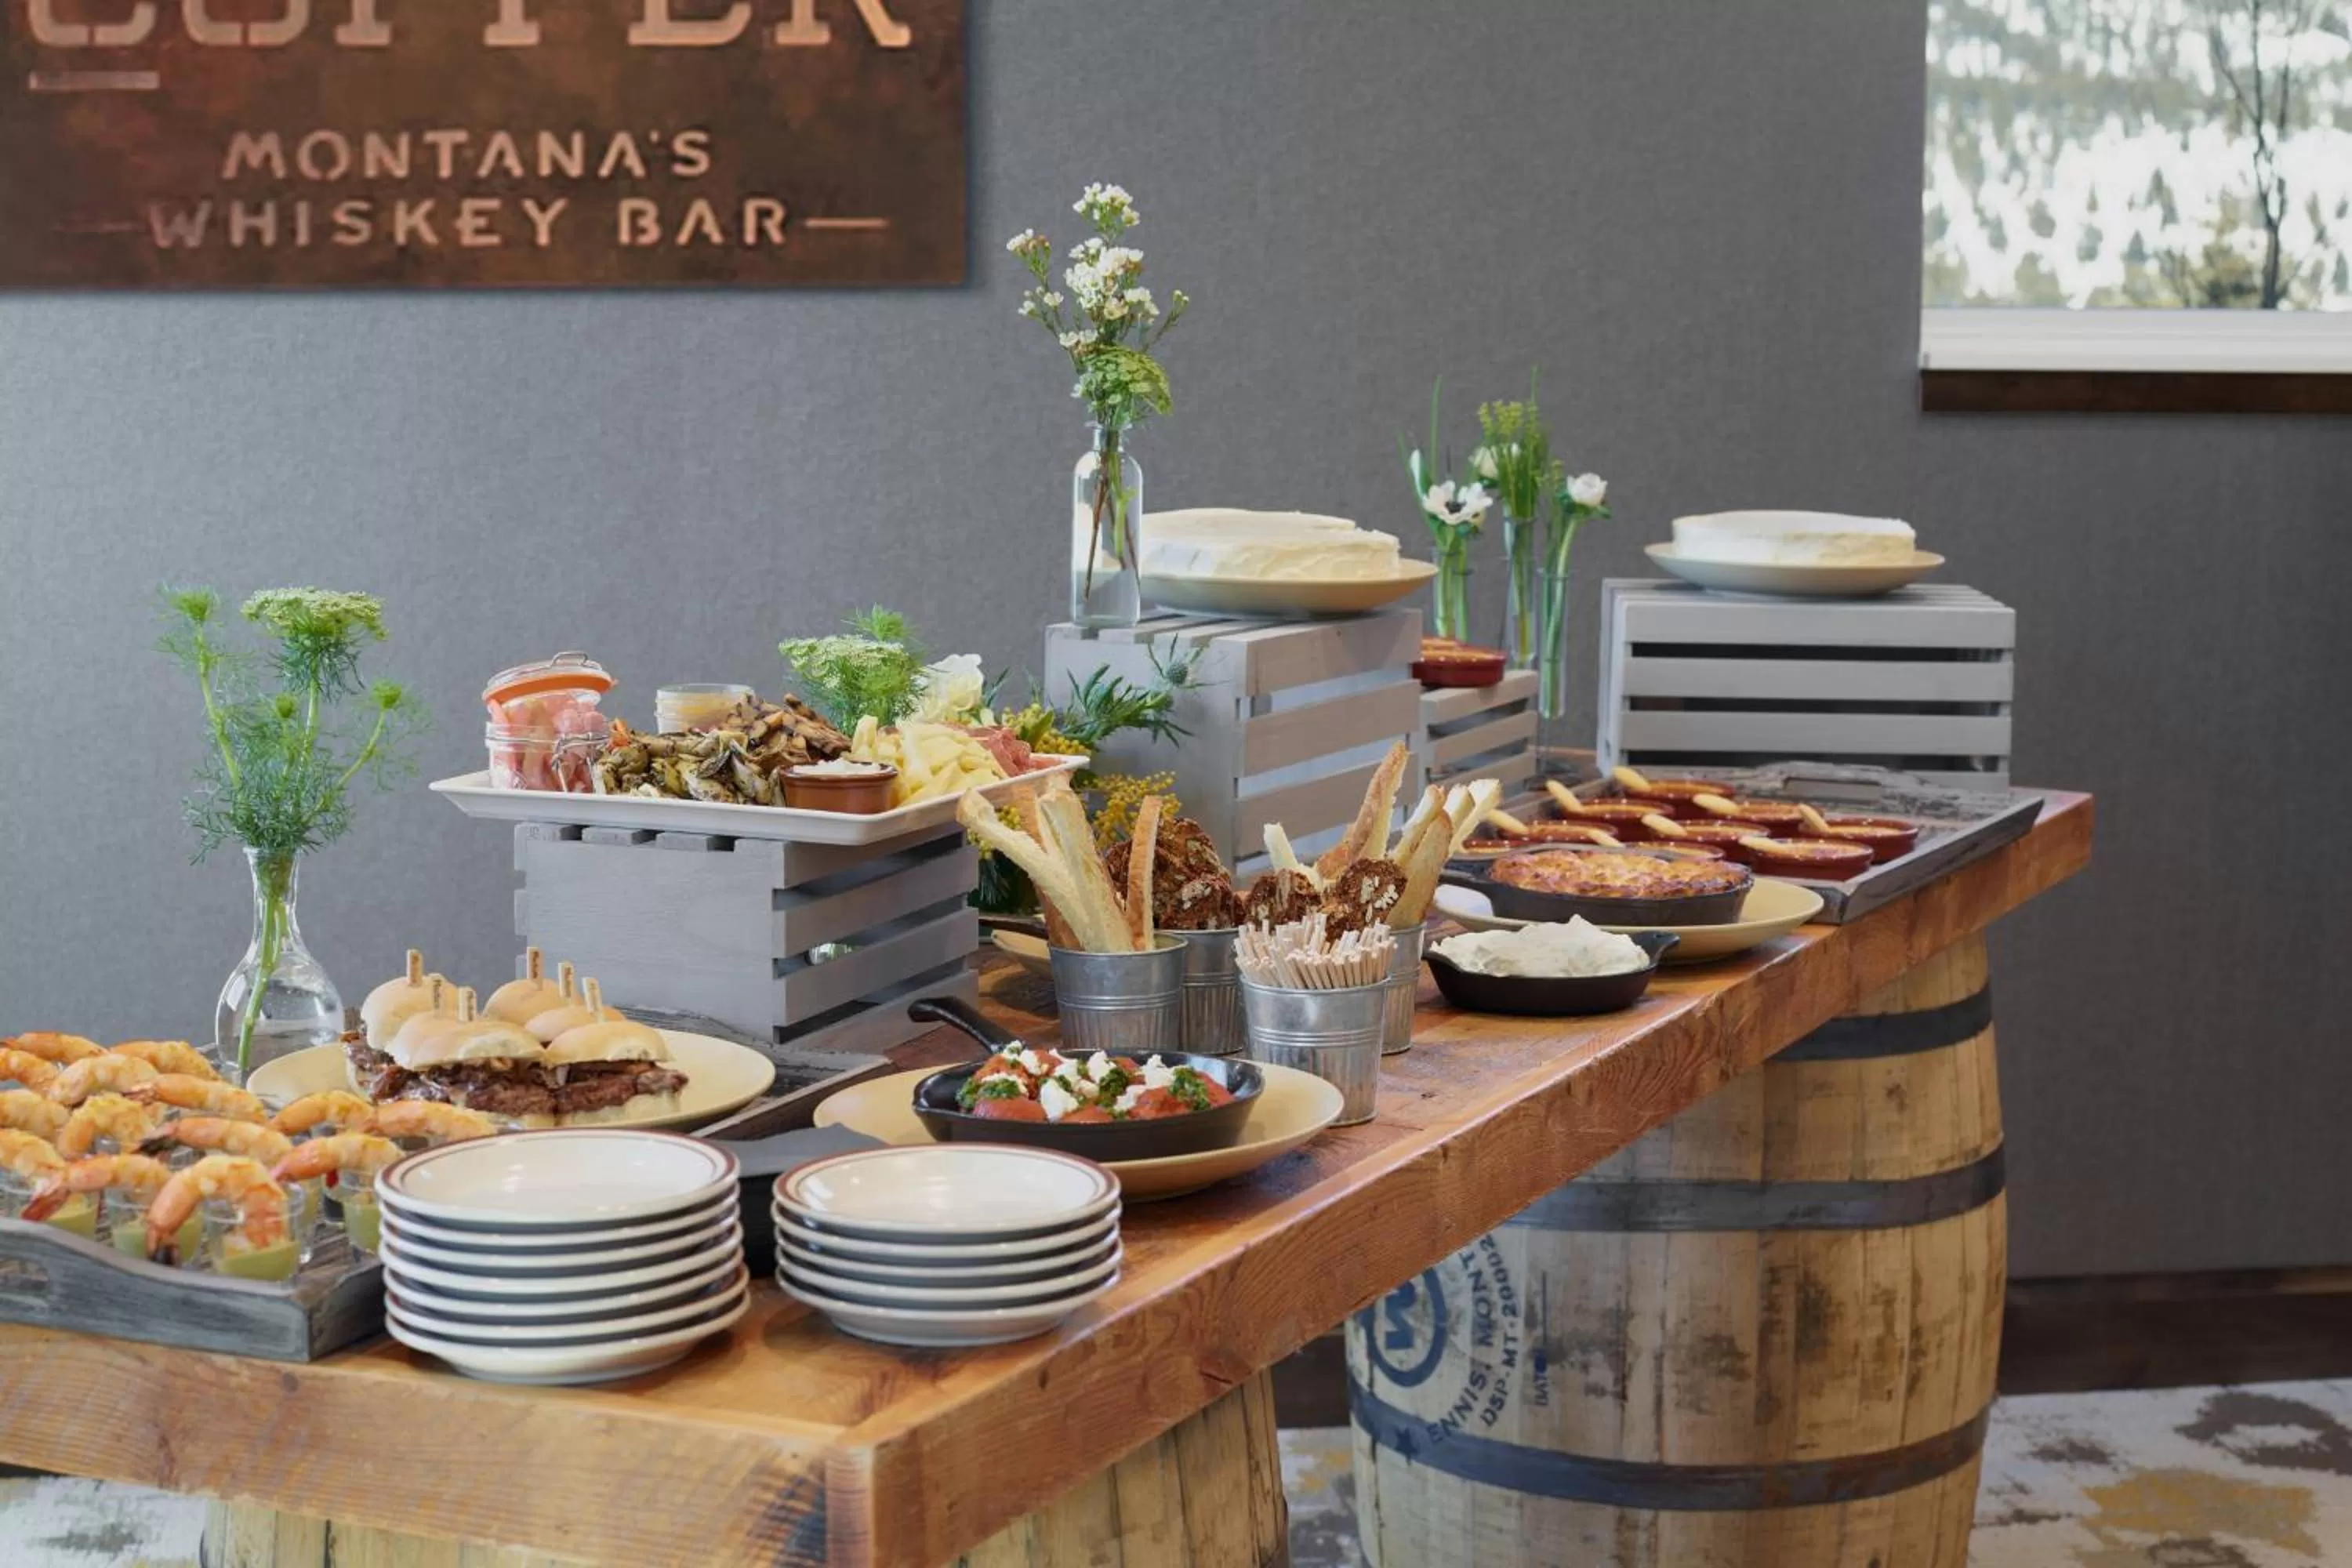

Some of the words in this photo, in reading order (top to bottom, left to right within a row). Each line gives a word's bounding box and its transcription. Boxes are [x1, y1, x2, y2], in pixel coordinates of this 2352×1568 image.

[222, 130, 710, 180] MONTANA'S
[147, 198, 569, 249] WHISKEY
[617, 198, 787, 247] BAR
